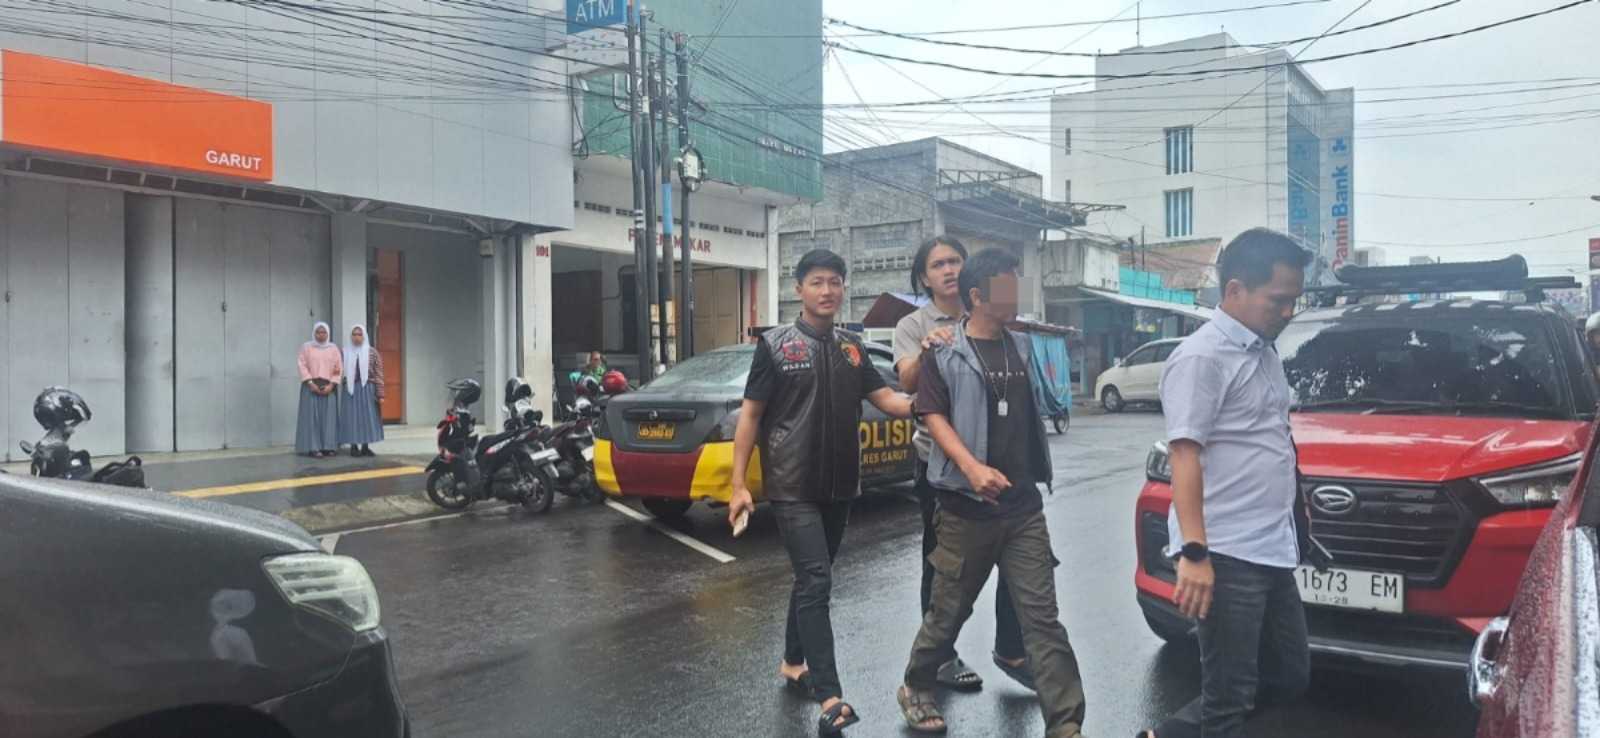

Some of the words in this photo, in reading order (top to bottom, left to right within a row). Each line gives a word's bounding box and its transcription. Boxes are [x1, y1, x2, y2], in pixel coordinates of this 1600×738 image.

[576, 0, 614, 22] ATM
[206, 149, 262, 170] GARUT
[858, 419, 911, 448] OLISI
[1371, 574, 1397, 599] EM
